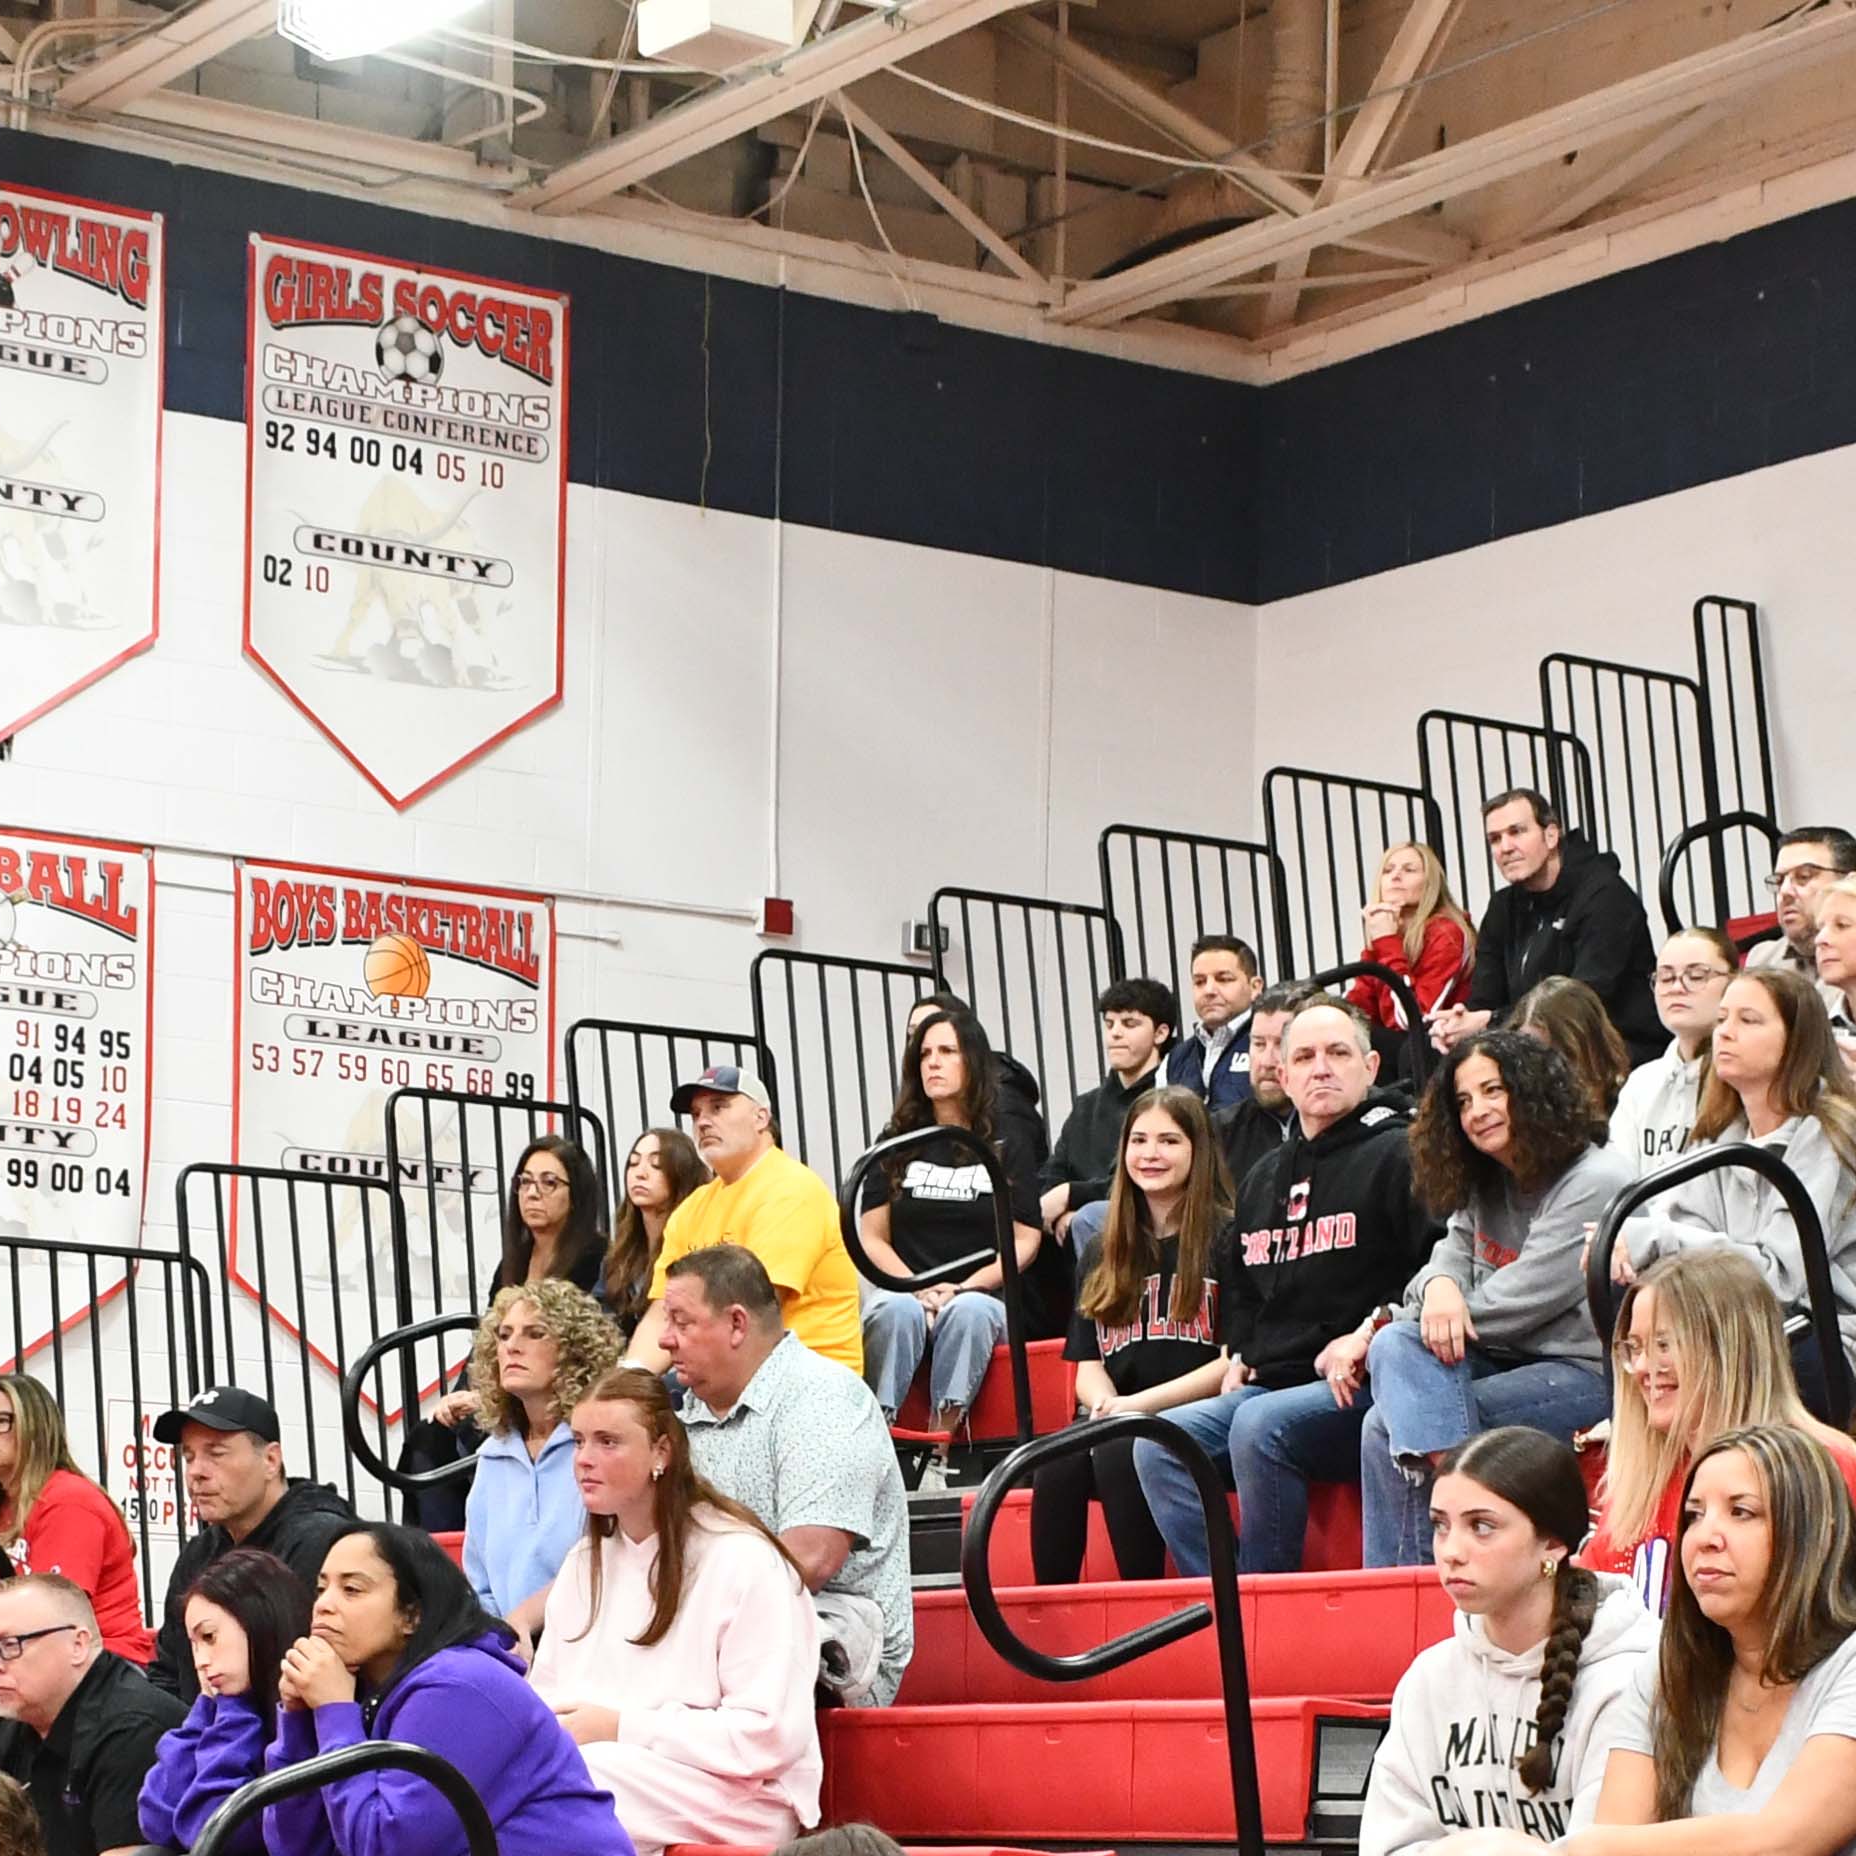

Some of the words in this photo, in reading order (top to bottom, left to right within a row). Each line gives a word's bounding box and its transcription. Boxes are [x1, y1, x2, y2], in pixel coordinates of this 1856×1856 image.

[264, 254, 385, 329] GIRLS
[393, 279, 553, 386] SOCCER
[263, 344, 549, 430] CHAMPIONS
[265, 421, 294, 451] 92
[306, 429, 337, 459] 94
[350, 437, 380, 467] 00
[393, 444, 423, 475] 04
[437, 453, 466, 482] 05
[480, 461, 504, 489] 10
[276, 389, 372, 425] LEAGUE
[382, 409, 539, 456] CONFERENCE
[264, 555, 292, 586] 02
[305, 564, 330, 593] 10
[313, 532, 495, 578] COUNTY
[249, 877, 337, 955] BOYS
[343, 887, 539, 989] BASKETBALL
[250, 967, 538, 1034] CHAMPIONS
[305, 1020, 484, 1055] LEAGUE
[252, 1044, 280, 1072] 53
[293, 1049, 323, 1077] 57
[338, 1053, 367, 1082] 59
[381, 1059, 410, 1086] 60
[426, 1063, 454, 1091] 65
[466, 1068, 493, 1095] 68
[506, 1073, 534, 1100] 99
